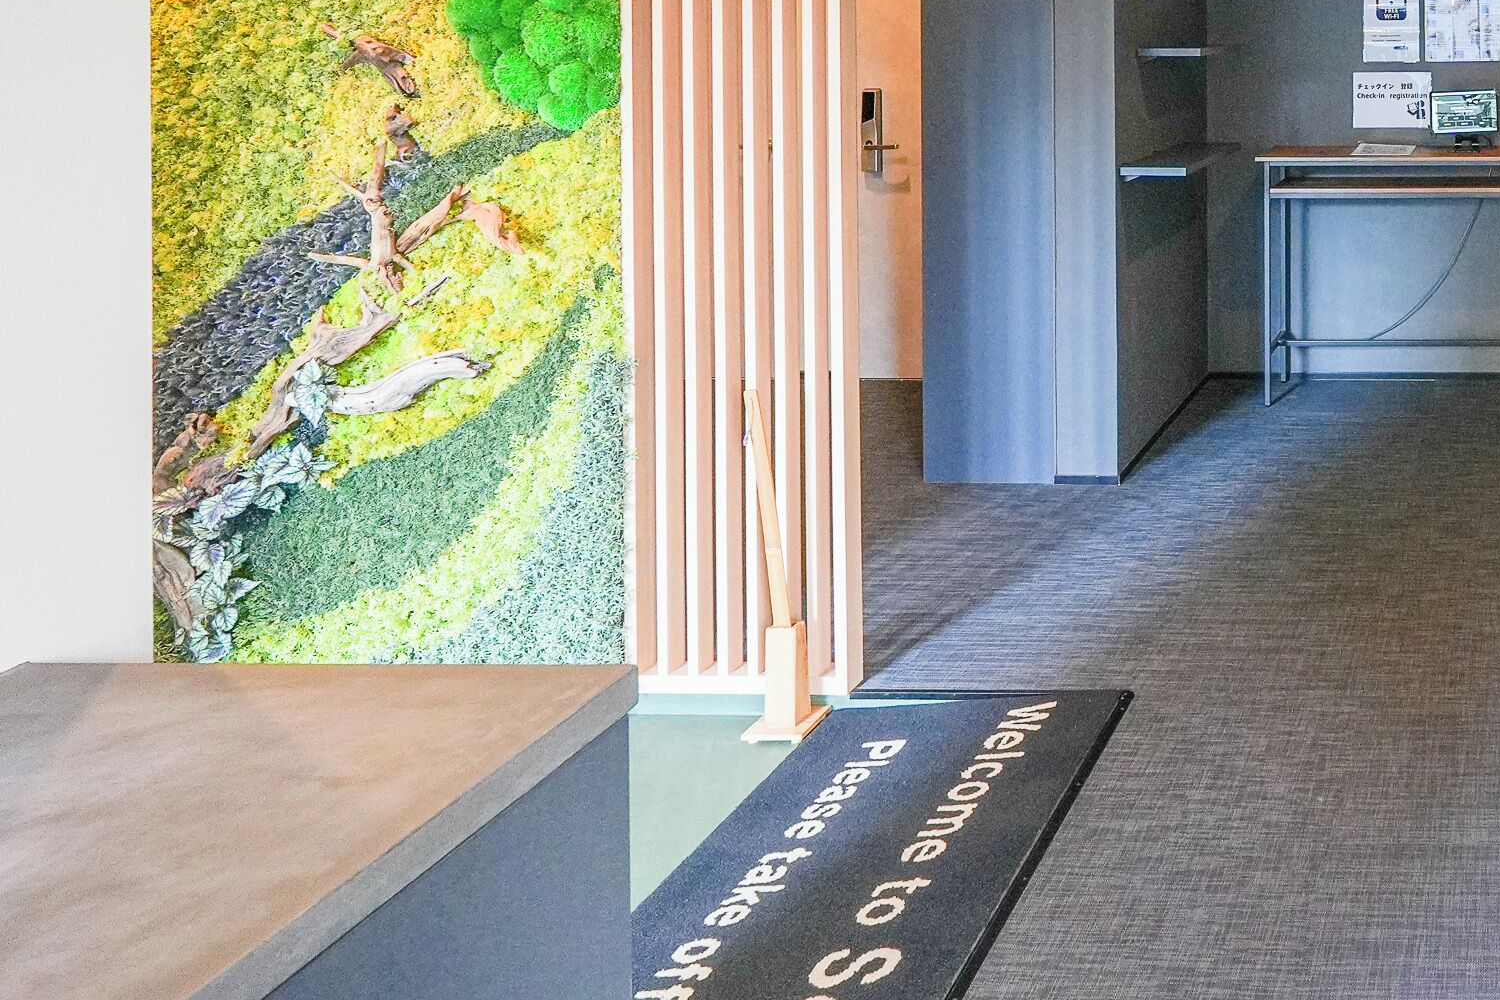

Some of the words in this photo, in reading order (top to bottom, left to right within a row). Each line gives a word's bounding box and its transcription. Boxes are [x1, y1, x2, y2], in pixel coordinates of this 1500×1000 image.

[1400, 82, 1413, 90] 登録
[784, 738, 907, 840] Please
[901, 700, 1057, 863] Welcome
[704, 848, 813, 927] take
[855, 877, 932, 926] to
[805, 947, 903, 1000] S
